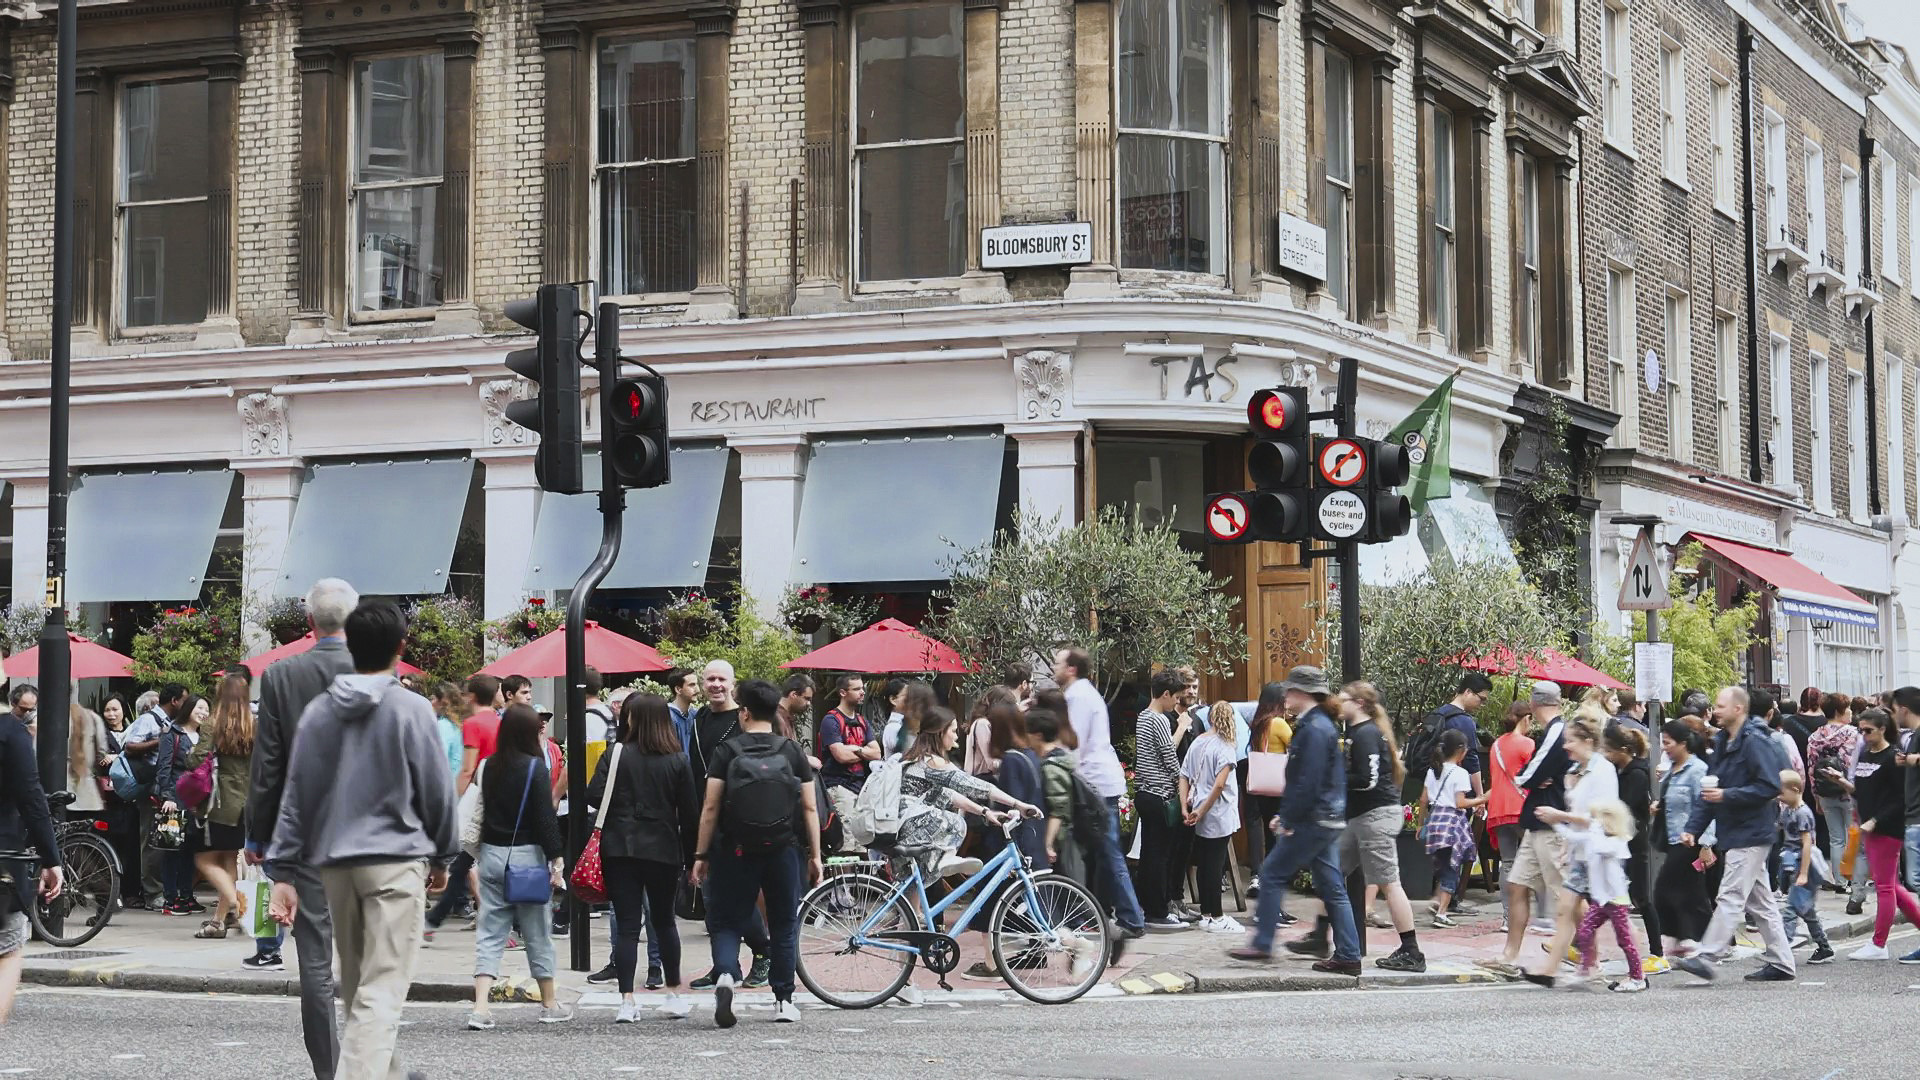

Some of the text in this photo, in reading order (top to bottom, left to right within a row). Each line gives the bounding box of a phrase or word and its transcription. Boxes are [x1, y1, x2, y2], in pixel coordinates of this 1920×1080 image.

[987, 235, 1068, 256] BLOOMSBURY
[1282, 228, 1324, 255] GT RUSSELL
[1283, 248, 1308, 267] STREET
[1151, 354, 1239, 402] TAS
[691, 397, 826, 423] RESTAURANT
[1330, 498, 1357, 508] Except
[1322, 509, 1363, 520] buses and
[1676, 501, 1714, 525] Museum
[1716, 510, 1760, 535] Superstore
[1329, 521, 1354, 531] cycles
